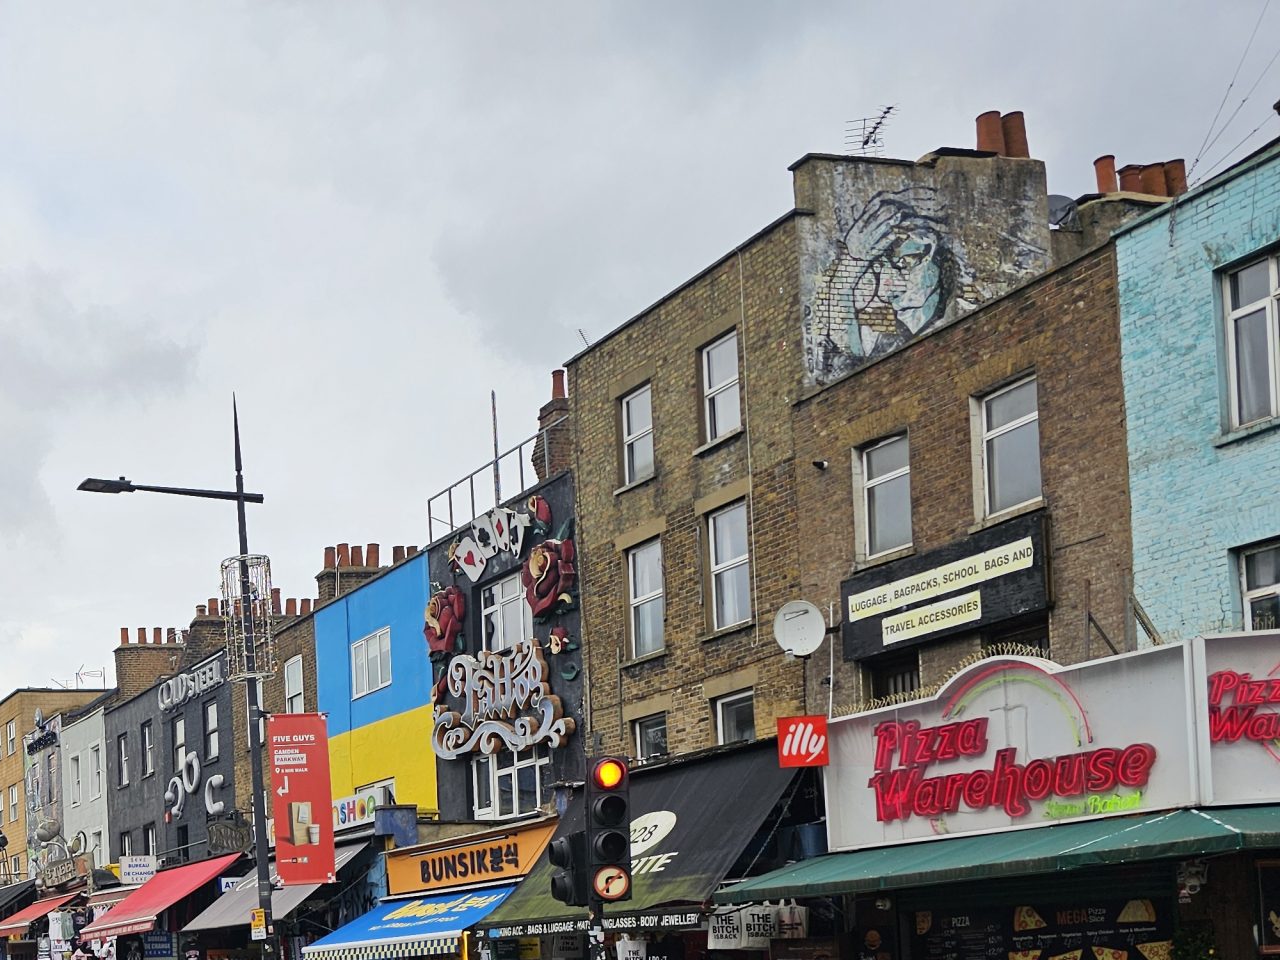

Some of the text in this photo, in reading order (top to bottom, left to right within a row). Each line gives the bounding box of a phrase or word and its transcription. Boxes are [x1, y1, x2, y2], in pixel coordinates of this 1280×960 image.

[850, 594, 888, 613] LUGGAGE
[893, 577, 941, 599] BAGPACKS,
[942, 564, 980, 584] SCHOOL
[984, 553, 1010, 571] BAGS
[1012, 546, 1033, 563] AND
[884, 600, 979, 636] TRAVEL ACCESSORIES
[1207, 705, 1280, 745] Wa
[292, 734, 315, 742] GUYS
[782, 722, 826, 763] illy
[873, 717, 989, 771] Pizza
[867, 742, 1158, 823] Warehouse
[420, 849, 489, 883] BUNSIK
[224, 881, 238, 889] AT
[527, 924, 543, 934] BAGS
[543, 923, 548, 934] &
[548, 921, 574, 933] LUGGAGE
[602, 917, 637, 928] NGLASSES
[640, 915, 658, 927] BODY
[661, 913, 700, 926] JEWELLERY
[715, 915, 734, 925] THE
[750, 913, 771, 923] THE
[951, 916, 970, 927] PIZZA
[1055, 909, 1089, 925] MEGA
[712, 925, 740, 934] BITCH
[745, 923, 776, 932] BITCH
